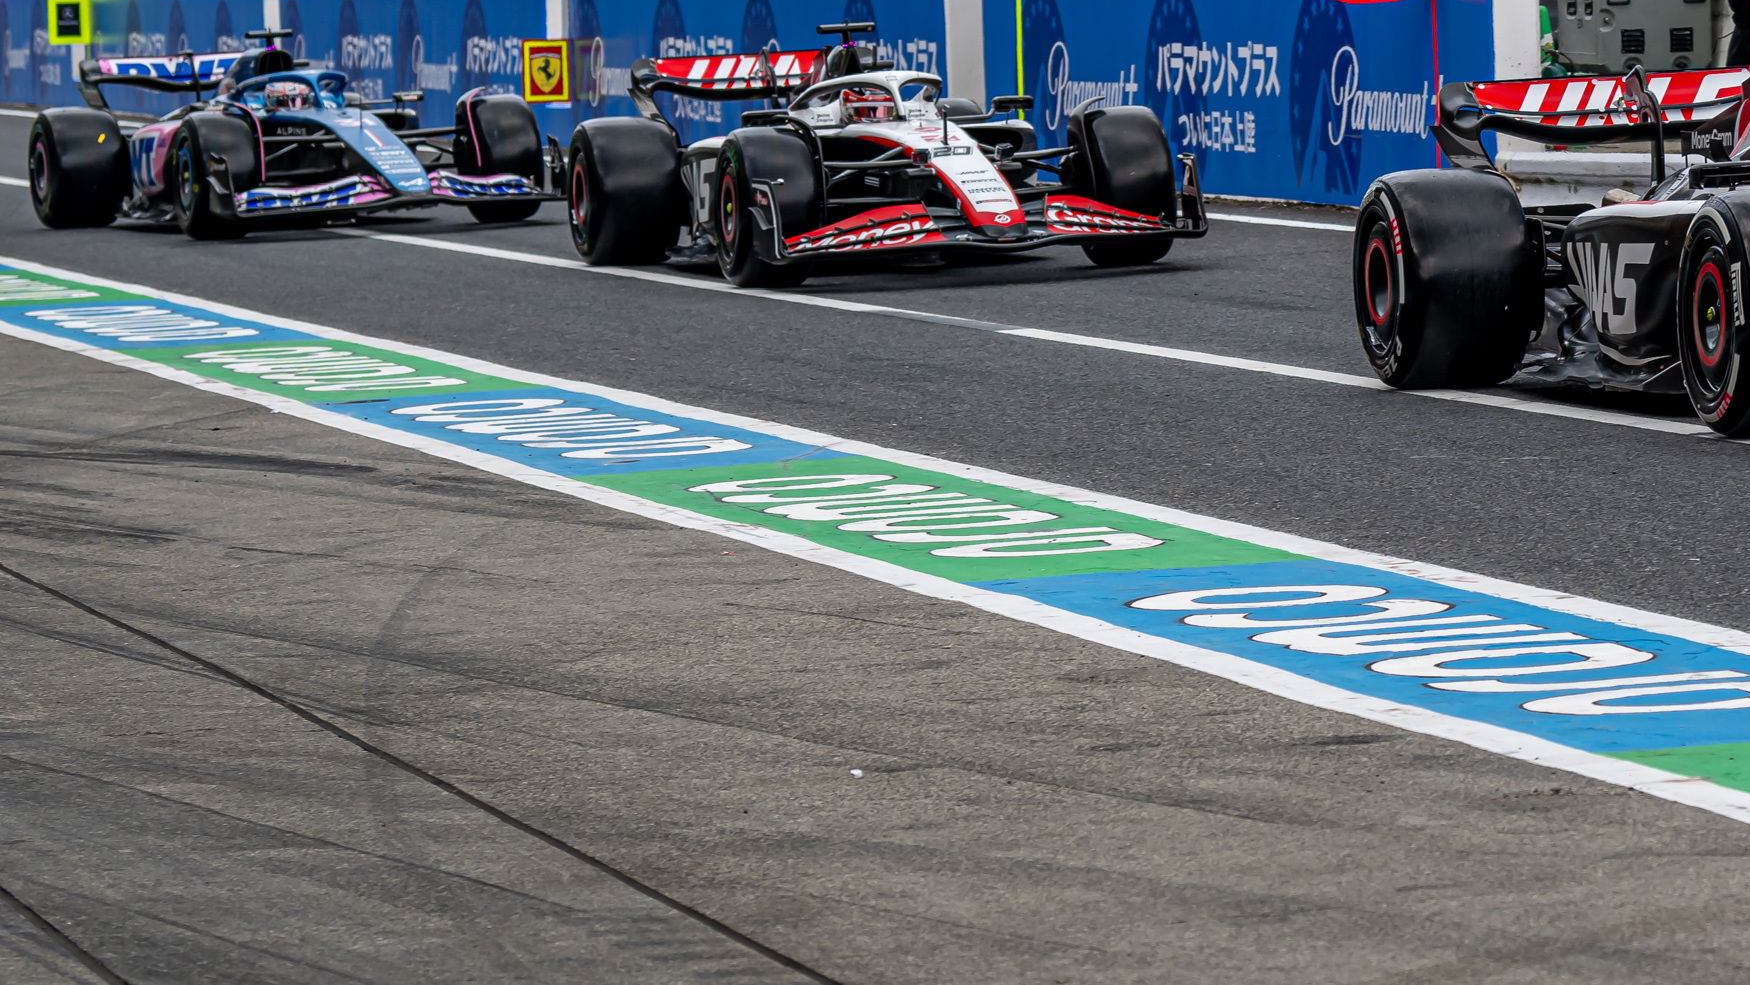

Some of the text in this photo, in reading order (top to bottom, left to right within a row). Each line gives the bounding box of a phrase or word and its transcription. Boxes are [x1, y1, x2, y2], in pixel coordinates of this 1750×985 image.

[1156, 40, 1281, 98] パラマウントプラス
[276, 128, 307, 136] ALPINE
[933, 146, 973, 156] 20
[1178, 110, 1256, 154] ついに日本上陸
[1691, 128, 1733, 151] MoneGram
[390, 398, 753, 459] aramco
[687, 474, 1166, 558] aramco
